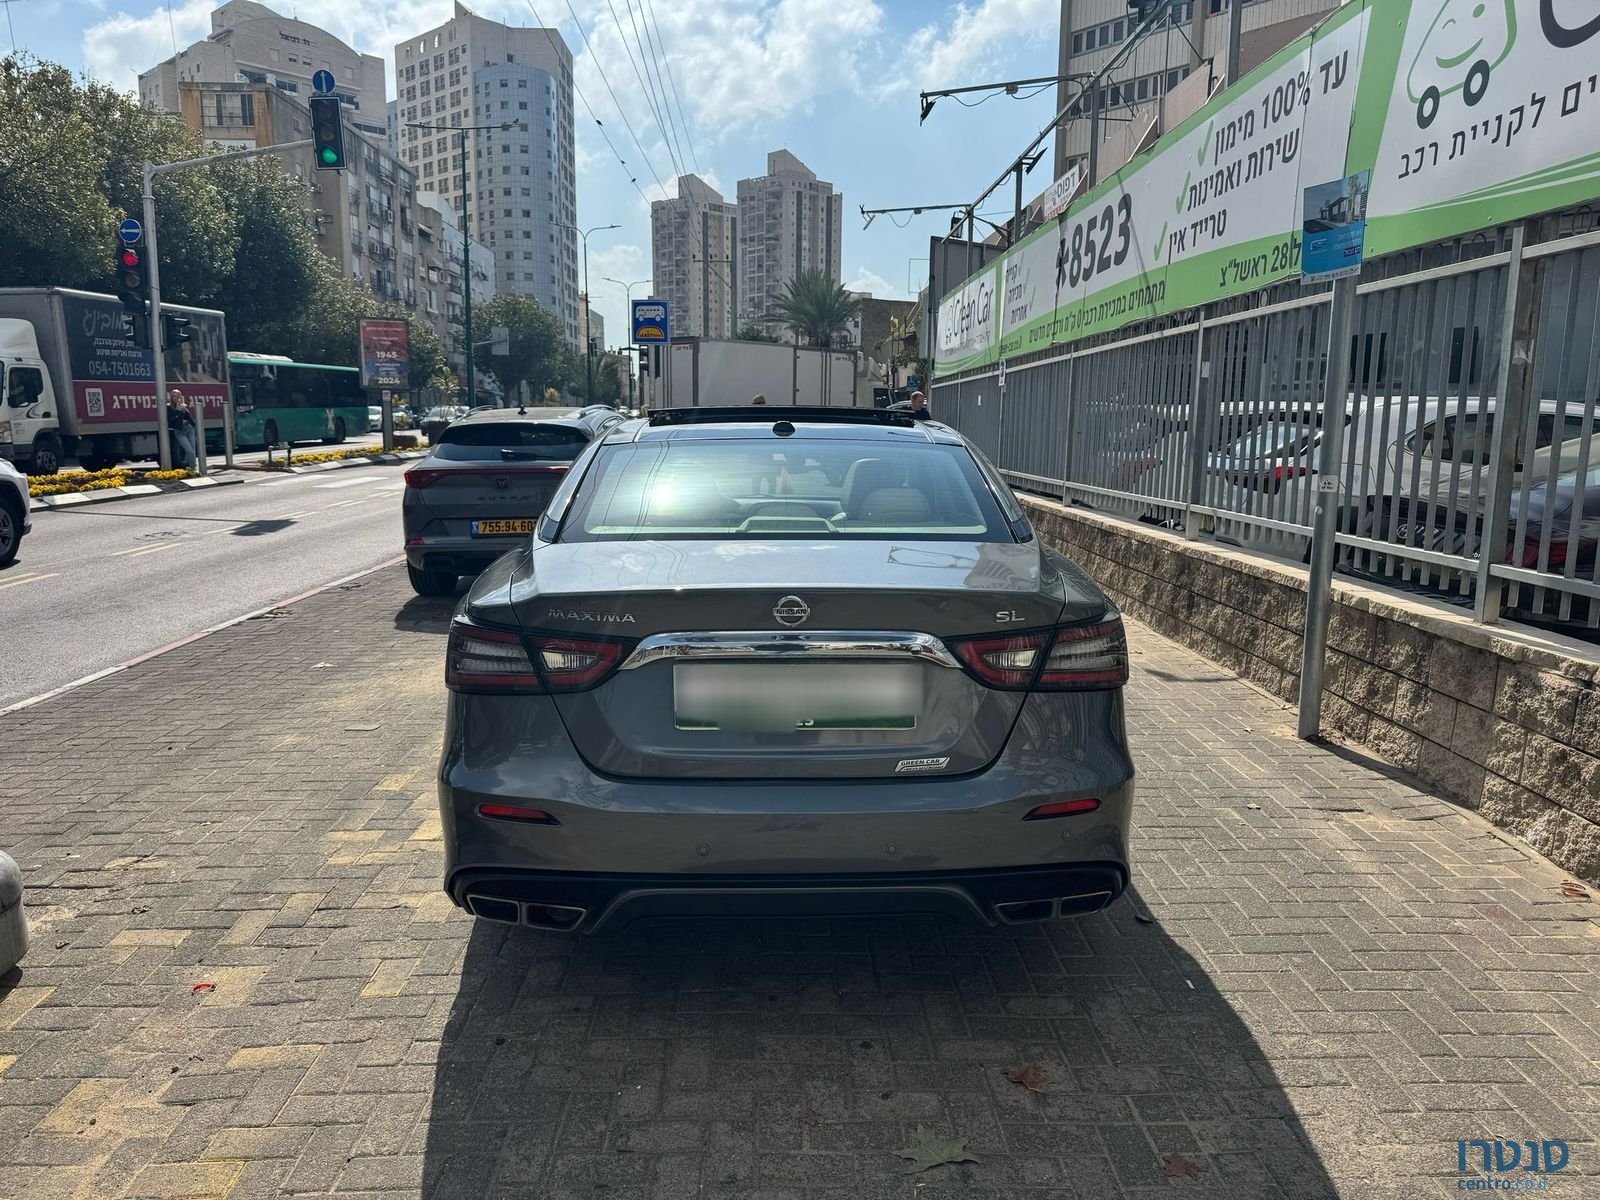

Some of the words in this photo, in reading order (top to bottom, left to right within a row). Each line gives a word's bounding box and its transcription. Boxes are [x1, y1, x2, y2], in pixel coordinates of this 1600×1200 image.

[1320, 50, 1348, 95] עד
[1262, 71, 1310, 129] 100%
[1214, 109, 1255, 165] מימון
[1449, 92, 1546, 160] לקניית
[1245, 128, 1300, 183] שירות
[1398, 141, 1439, 179] רכב
[1187, 158, 1242, 211] ואמינות
[1168, 226, 1187, 263] אין
[1190, 208, 1227, 247] טרייד
[1270, 242, 1290, 273] 28
[977, 282, 994, 326] Car
[1099, 295, 1127, 320] במכירת
[1128, 280, 1166, 310] מתמחים
[88, 360, 151, 377] 054-7501663
[376, 351, 398, 359] 1945
[377, 377, 401, 385] 2024
[548, 609, 636, 623] MAXIMA
[995, 610, 1026, 623] SL
